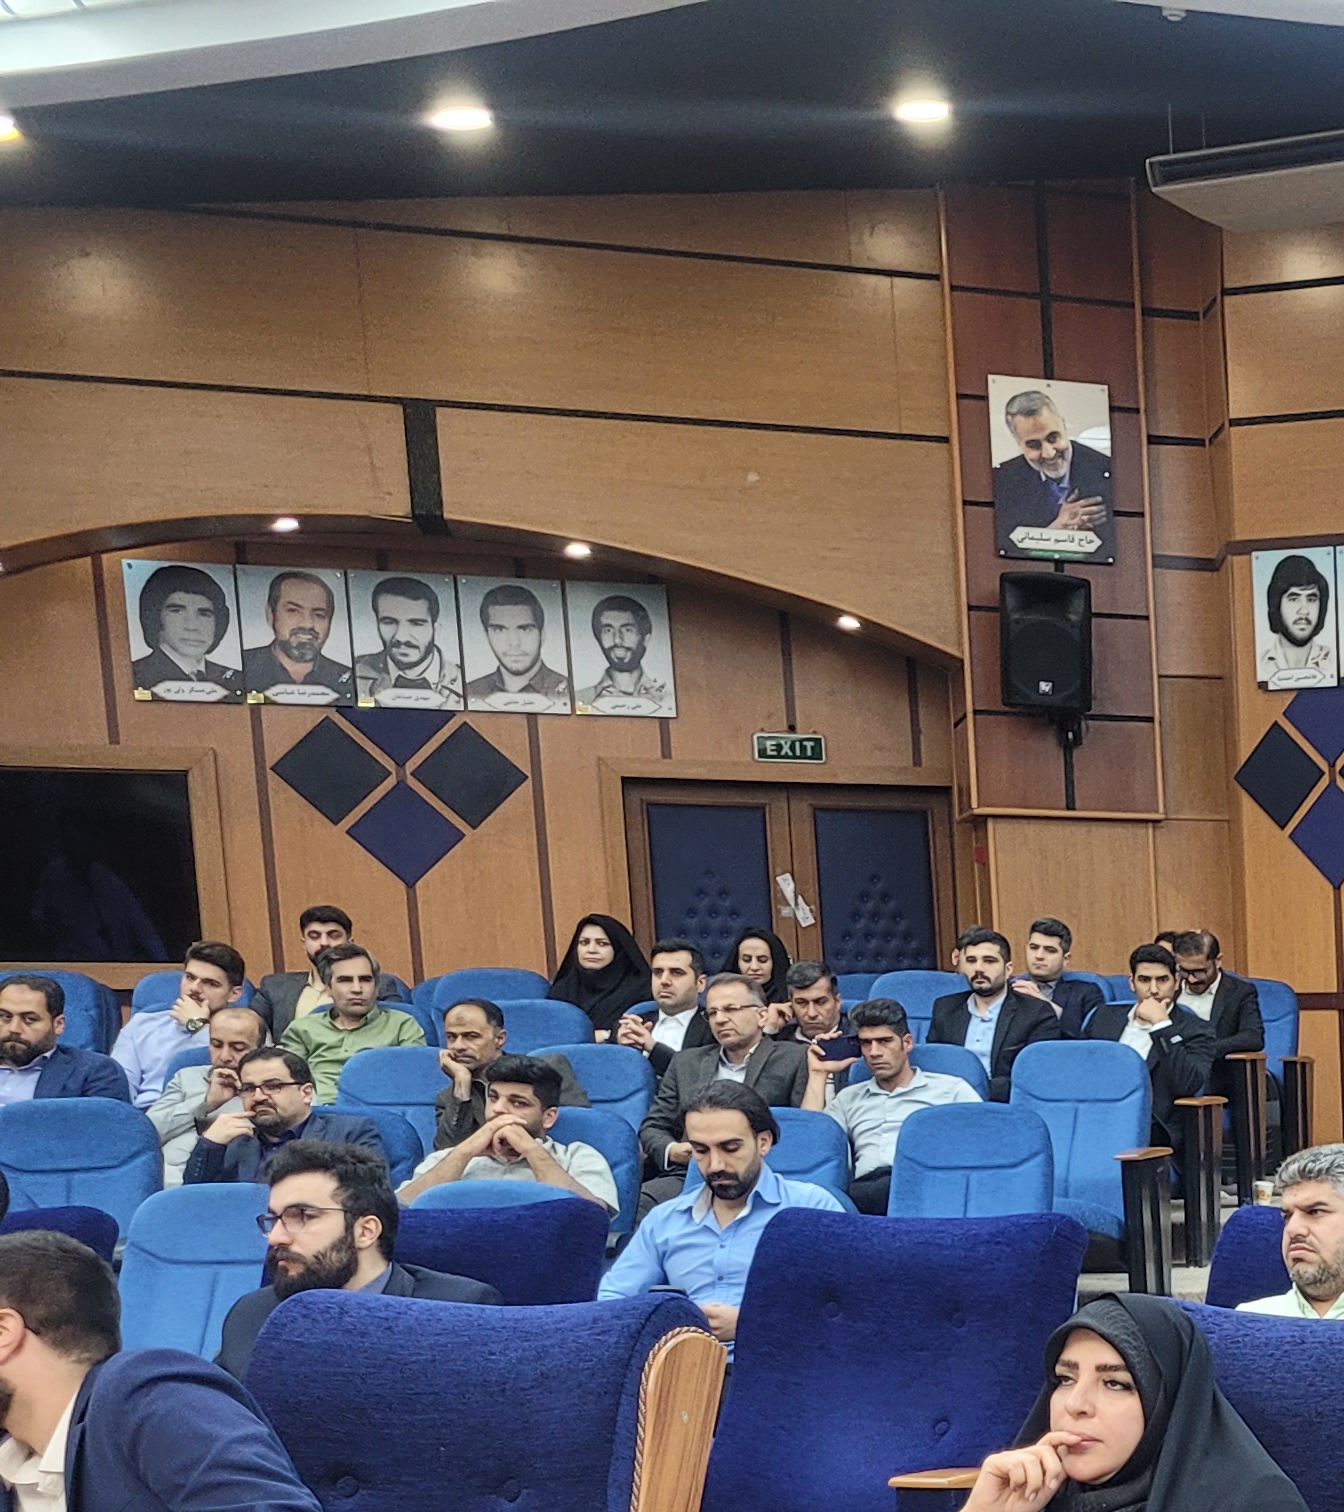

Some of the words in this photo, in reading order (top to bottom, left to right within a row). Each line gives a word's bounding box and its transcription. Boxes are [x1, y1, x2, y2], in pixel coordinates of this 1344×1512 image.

[1016, 528, 1052, 544] سلیمانی
[1054, 532, 1075, 545] قاسم
[1077, 534, 1095, 548] حاج
[765, 740, 815, 757] EXIT
